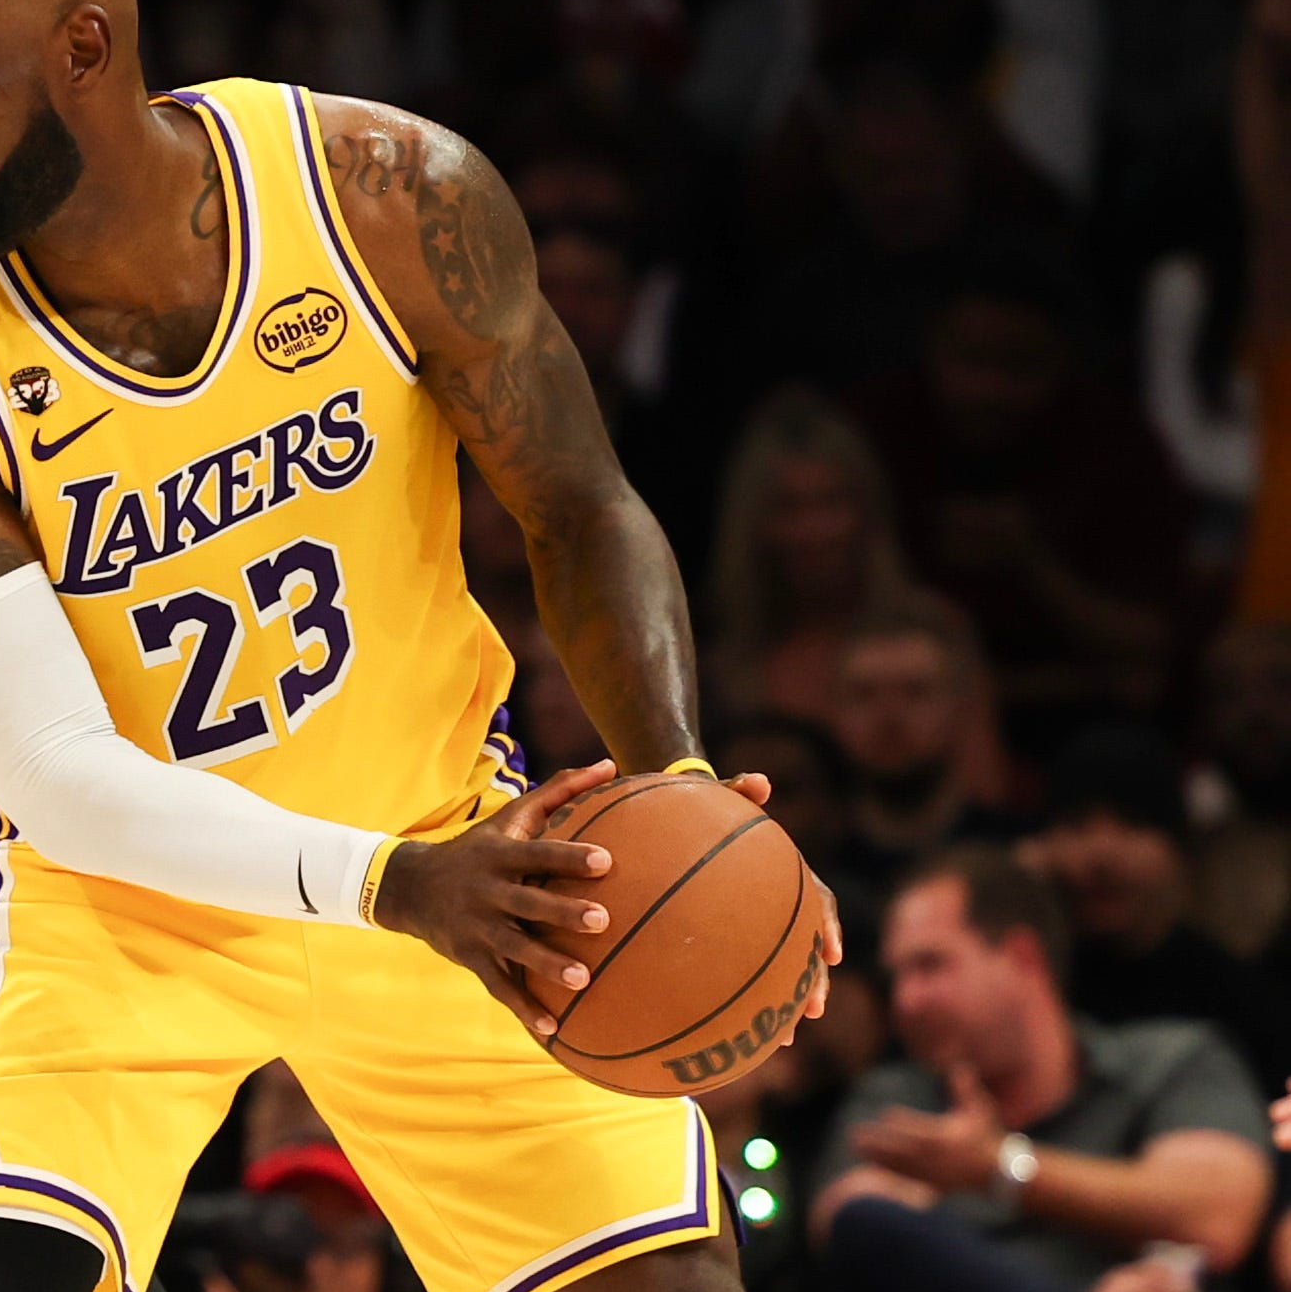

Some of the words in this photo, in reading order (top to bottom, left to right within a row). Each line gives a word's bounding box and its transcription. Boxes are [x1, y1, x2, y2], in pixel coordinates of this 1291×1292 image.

[260, 305, 340, 353] bibigo
[282, 335, 317, 357] 비비고
[53, 390, 375, 597] LAKERS
[128, 536, 354, 769] 23
